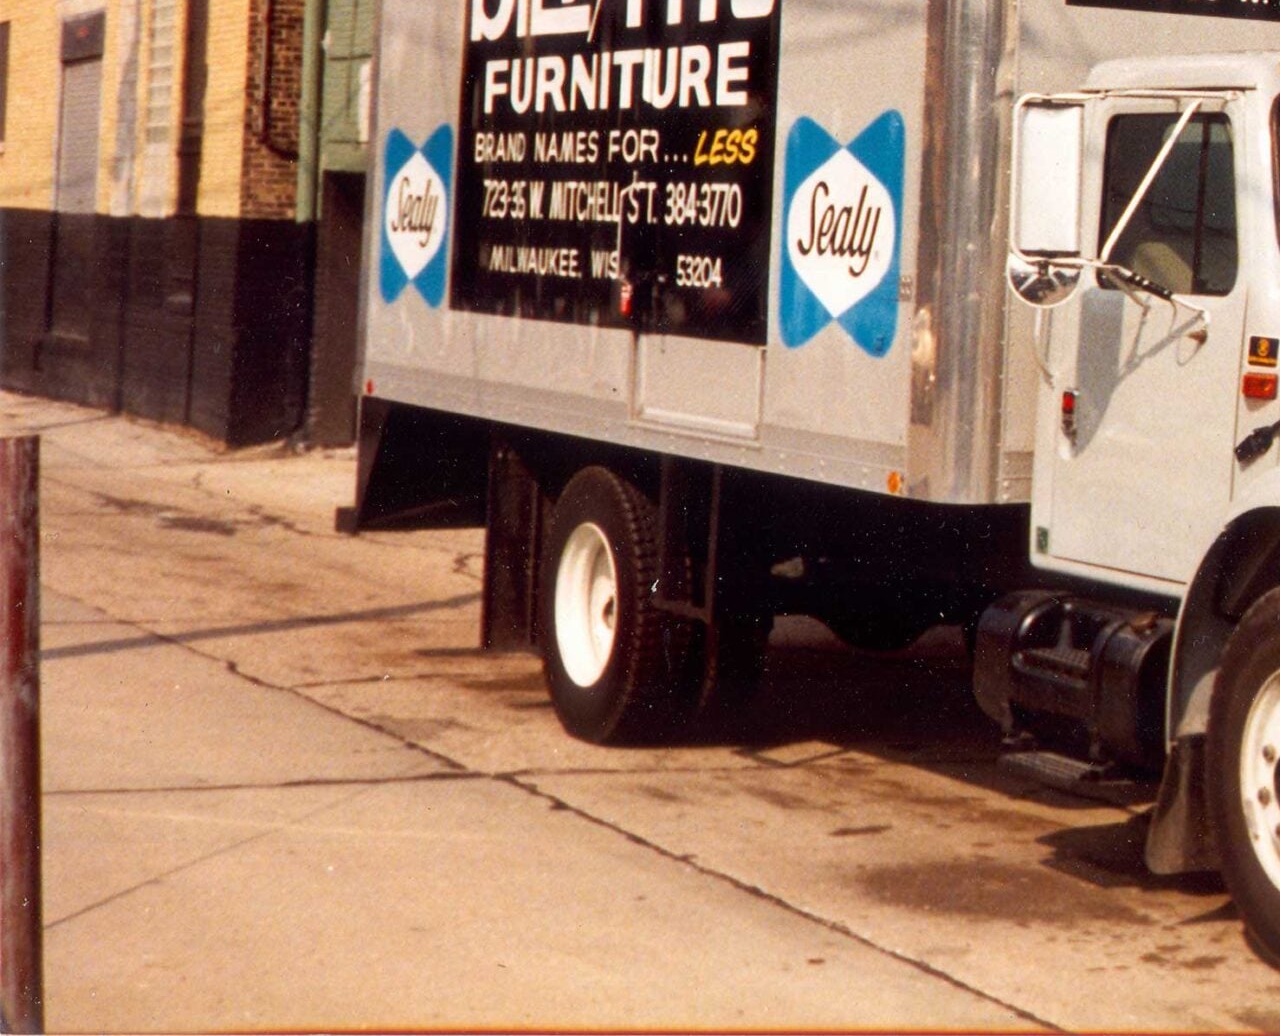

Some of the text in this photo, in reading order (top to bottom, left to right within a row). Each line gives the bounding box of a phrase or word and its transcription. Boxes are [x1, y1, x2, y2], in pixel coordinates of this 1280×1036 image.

[483, 42, 751, 114] FURNITURE
[474, 131, 526, 164] BRAND
[533, 131, 599, 163] NAMES
[693, 128, 759, 166] LESS
[391, 176, 440, 249] Sealy
[548, 180, 621, 223] MITCHELL
[664, 181, 743, 228] 384-3770
[799, 180, 882, 277] Sealy
[675, 254, 723, 289] 53204
